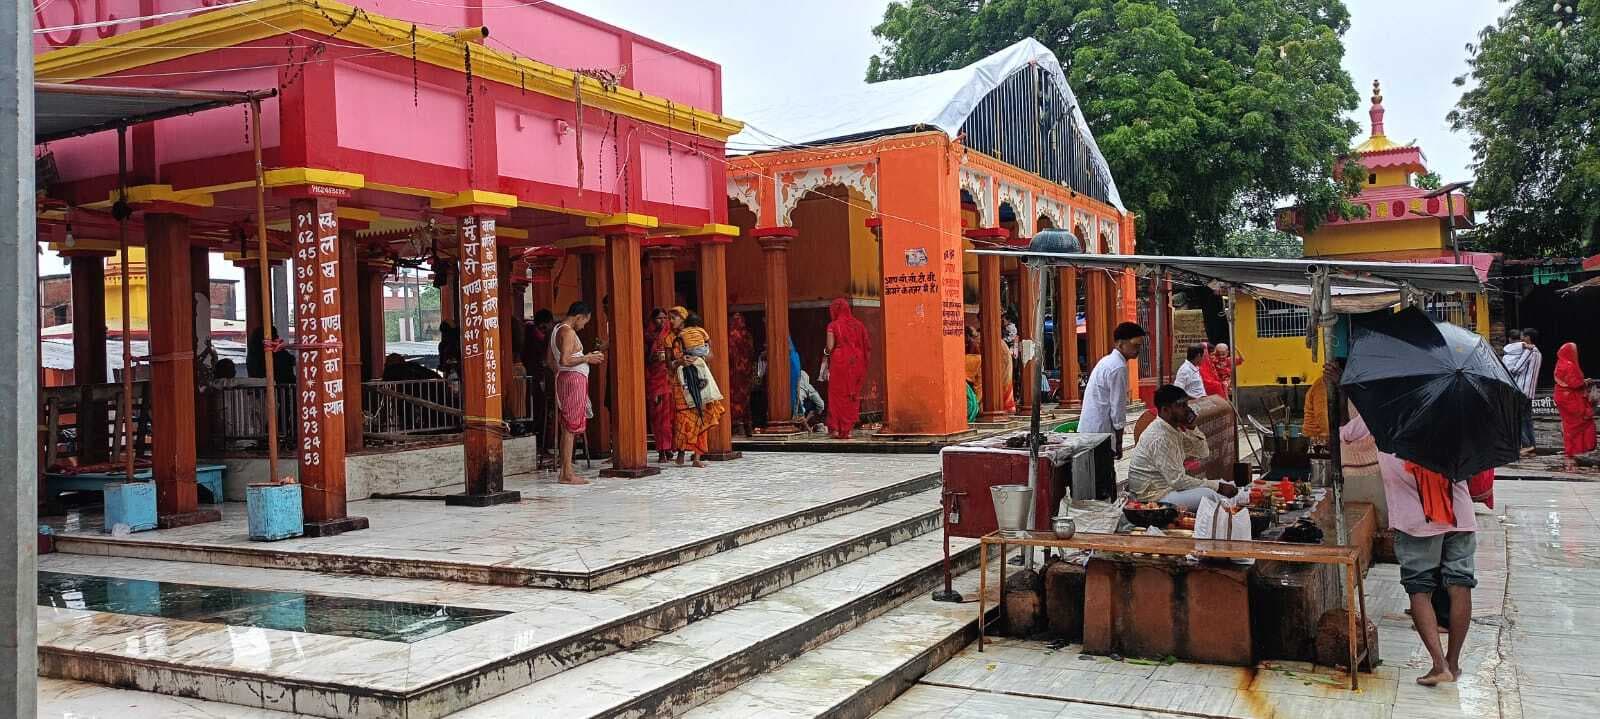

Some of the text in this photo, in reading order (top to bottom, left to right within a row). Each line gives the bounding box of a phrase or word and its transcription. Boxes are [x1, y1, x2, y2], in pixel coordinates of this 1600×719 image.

[298, 212, 312, 228] 91
[298, 230, 314, 244] 62
[299, 246, 316, 261] 45
[297, 264, 314, 278] 36
[299, 281, 314, 294] 96
[464, 301, 478, 316] 95
[301, 317, 317, 331] 73
[465, 315, 483, 327] 079
[465, 343, 479, 355] 55
[485, 336, 493, 349] 91
[302, 350, 318, 363] 97
[485, 349, 494, 360] 62
[323, 358, 340, 373] का
[486, 360, 496, 370] 45
[303, 366, 318, 379] 19
[486, 371, 496, 382] 36
[324, 379, 343, 398] पूजा
[486, 383, 496, 395] 96
[302, 390, 316, 403] 99
[302, 406, 318, 420] 34
[303, 436, 321, 450] 24
[304, 452, 320, 465] 53
